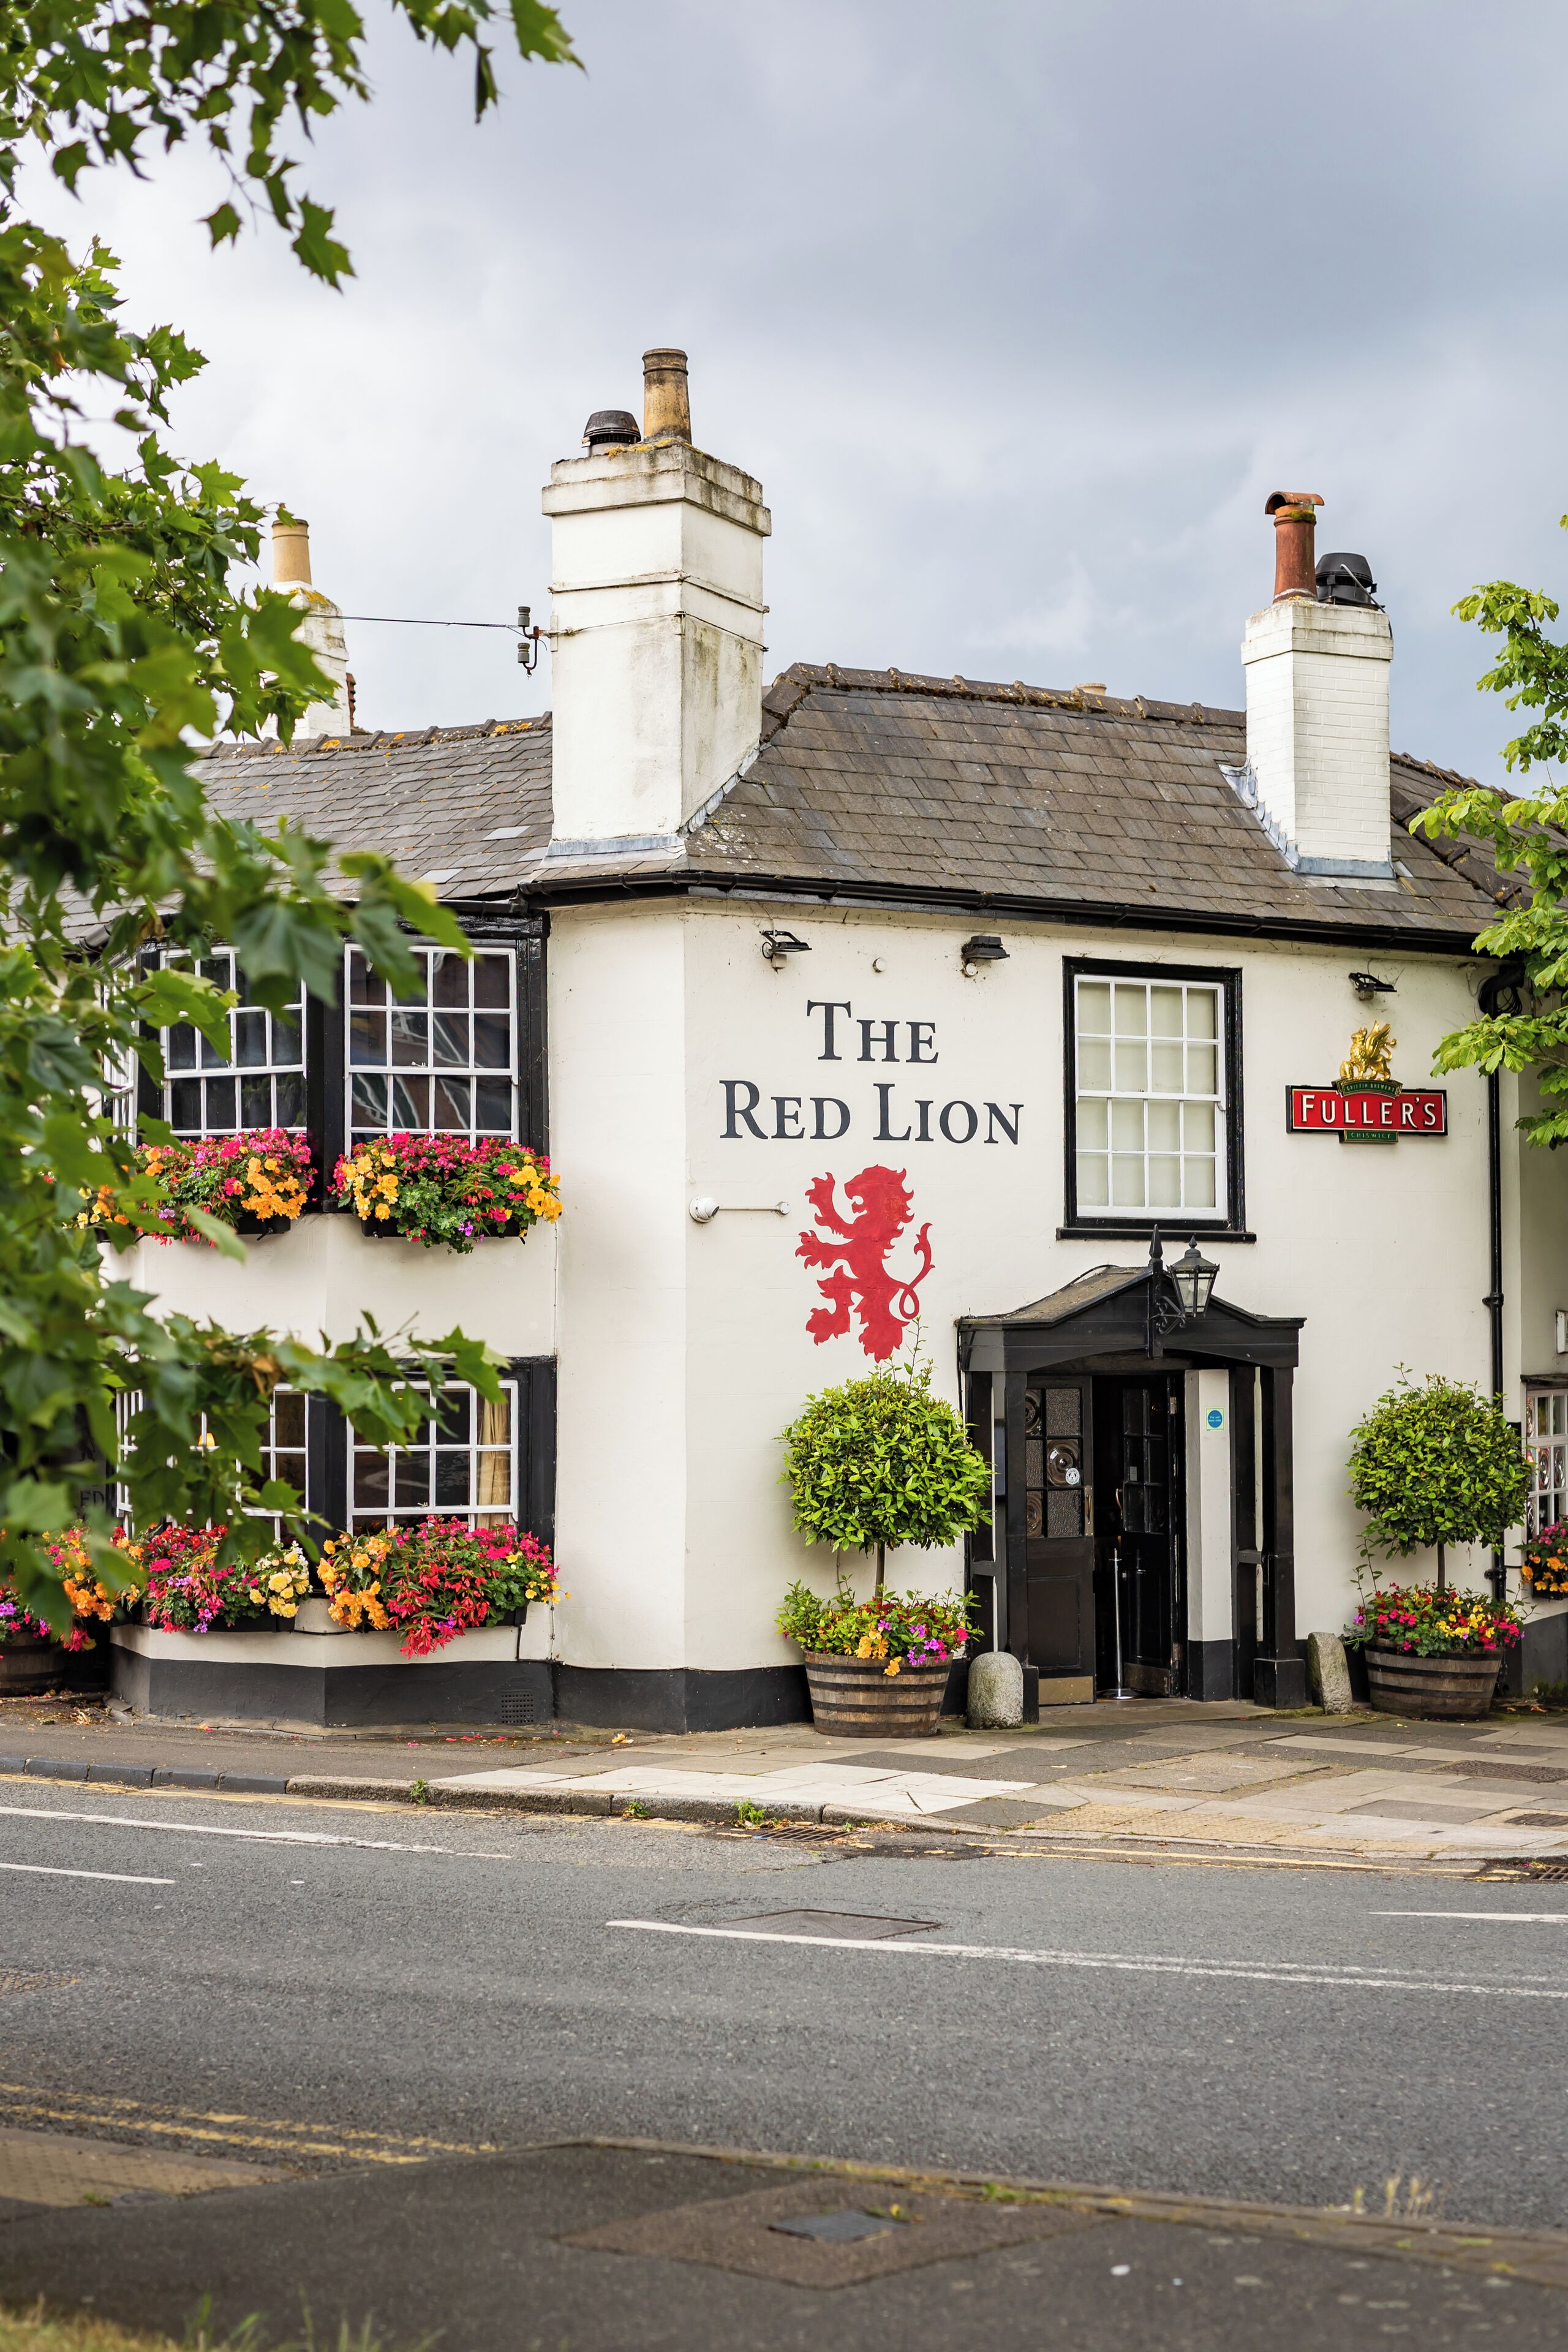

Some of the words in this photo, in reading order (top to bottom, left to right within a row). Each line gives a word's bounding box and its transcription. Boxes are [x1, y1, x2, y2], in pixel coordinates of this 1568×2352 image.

[806, 1000, 939, 1064] THE
[719, 1080, 851, 1140] RED
[872, 1083, 1024, 1145] LION
[1301, 1093, 1436, 1129] FULLER'S
[1346, 1082, 1368, 1091] GRIFFIN
[1370, 1082, 1395, 1093] BREWERY
